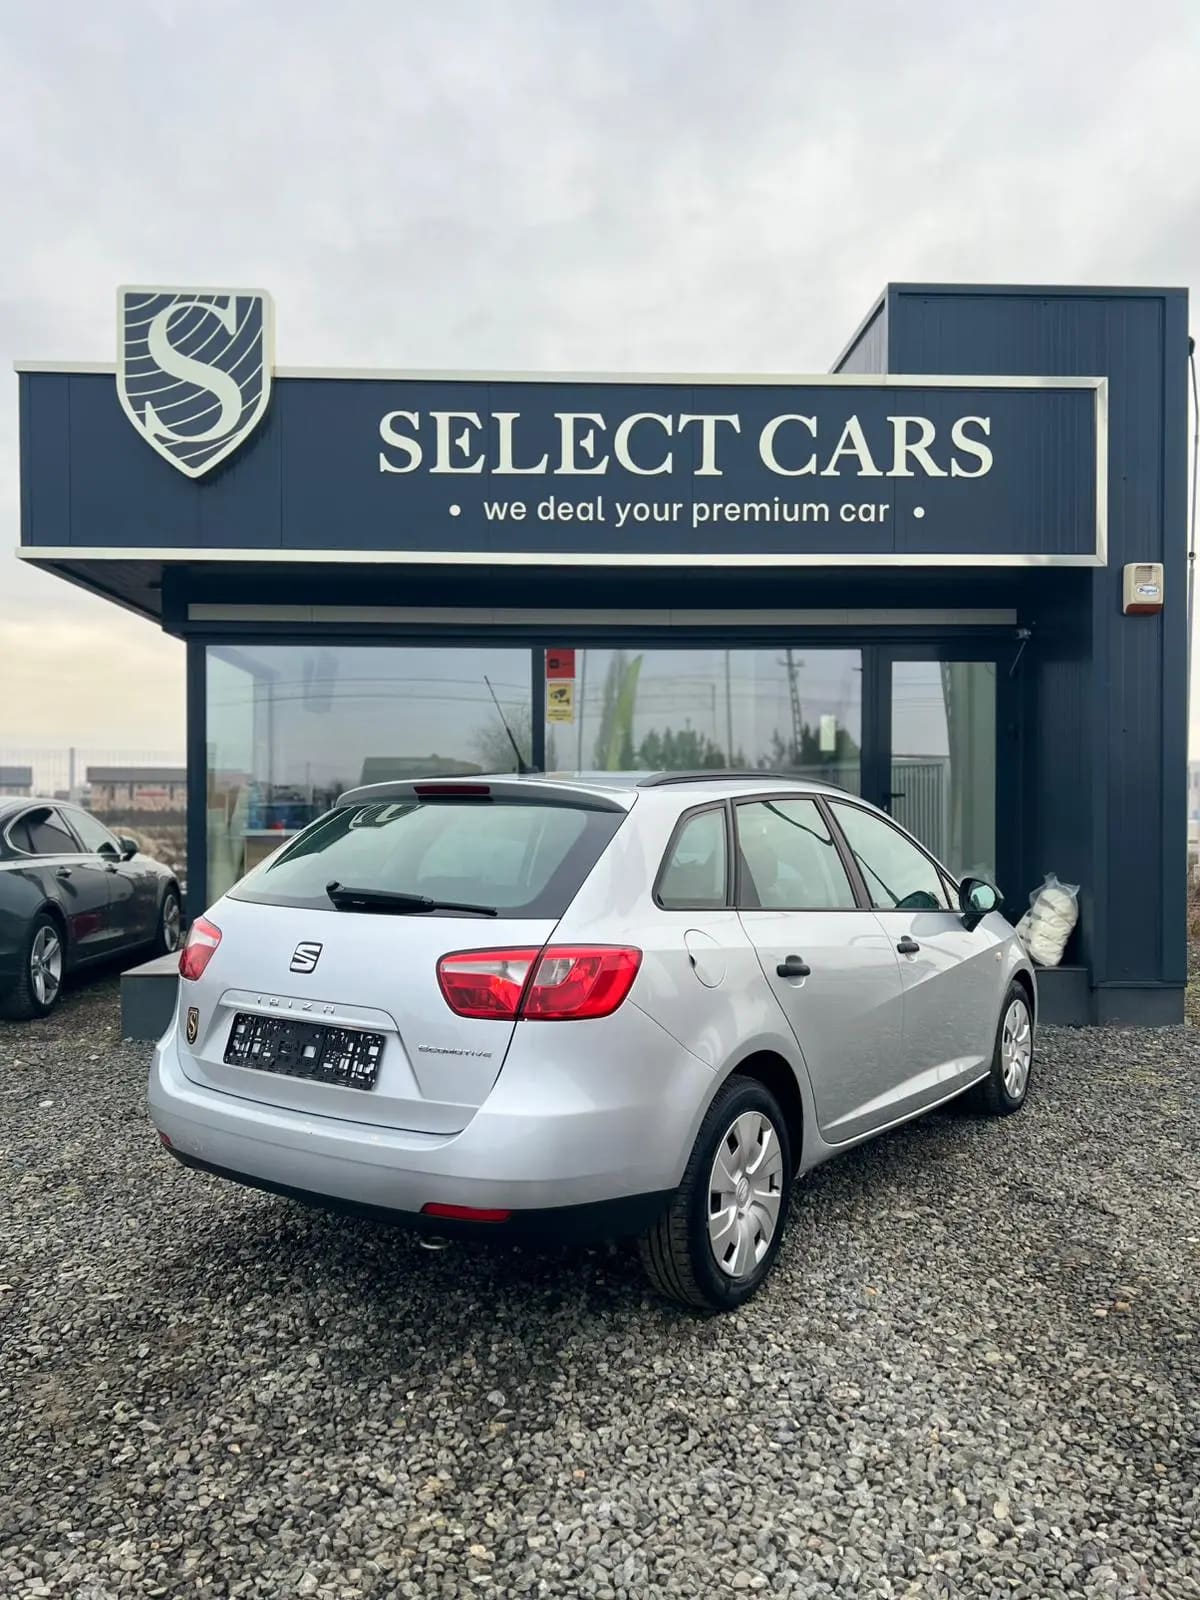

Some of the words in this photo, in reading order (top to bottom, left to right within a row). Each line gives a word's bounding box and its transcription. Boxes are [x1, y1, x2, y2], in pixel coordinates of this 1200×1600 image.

[145, 296, 242, 443] S
[379, 410, 741, 477] SELECT
[759, 413, 993, 478] CARS
[483, 501, 527, 521] we
[537, 495, 606, 521] deal
[615, 502, 683, 528] your
[692, 496, 829, 528] premium
[839, 503, 890, 522] car
[257, 995, 335, 1015] IBIZA
